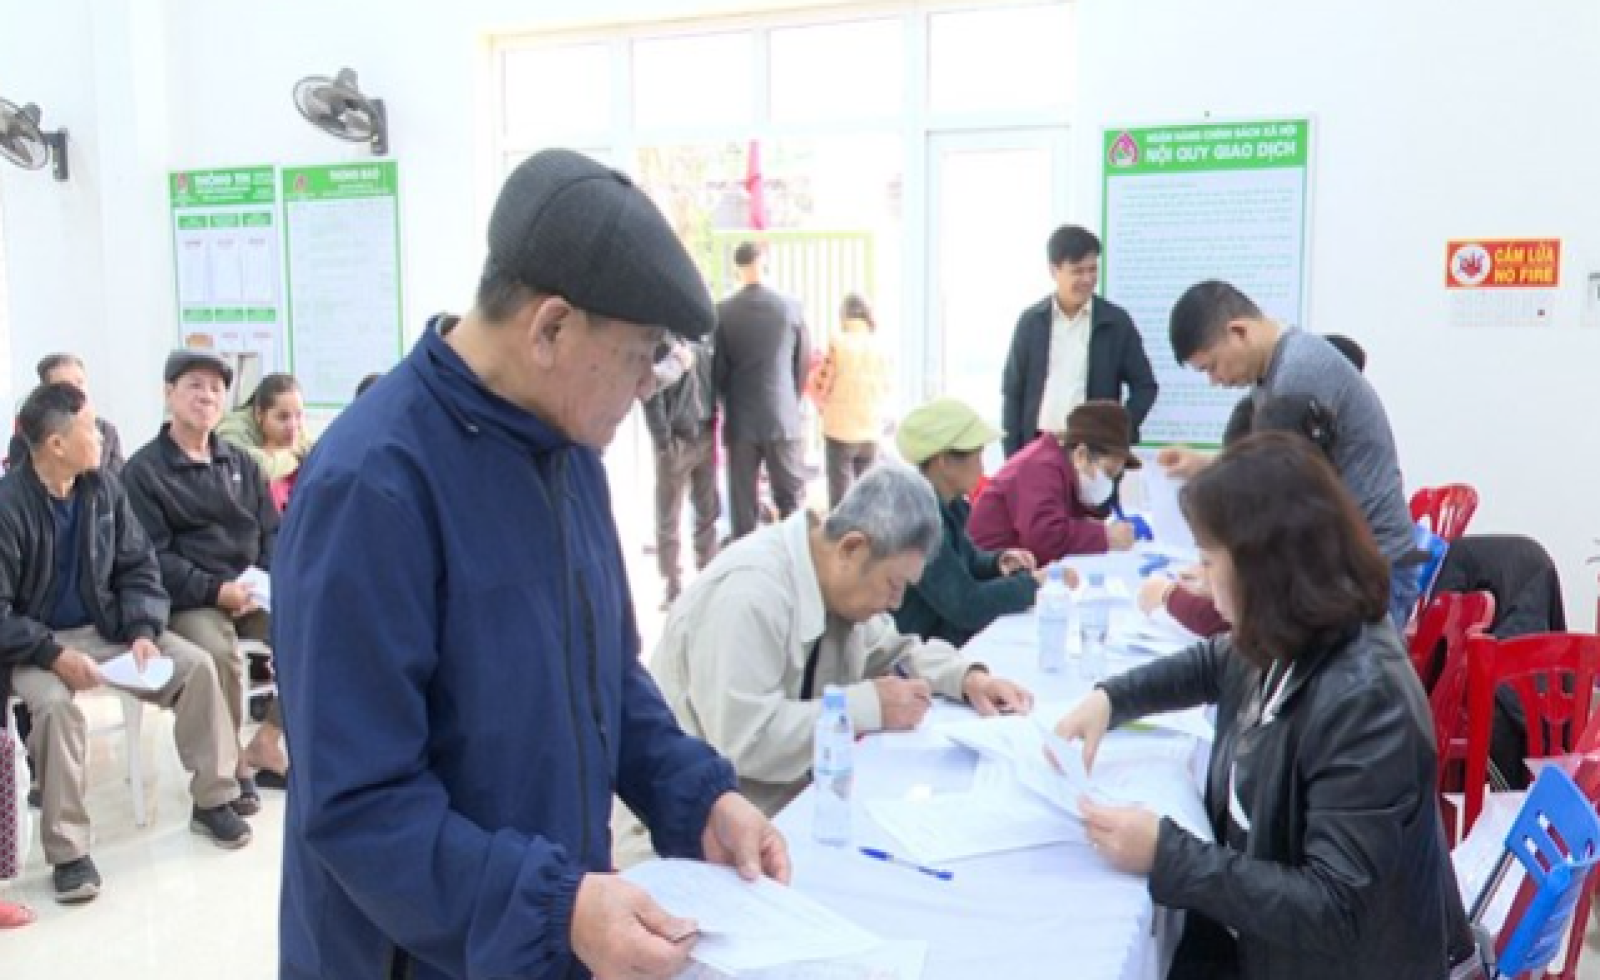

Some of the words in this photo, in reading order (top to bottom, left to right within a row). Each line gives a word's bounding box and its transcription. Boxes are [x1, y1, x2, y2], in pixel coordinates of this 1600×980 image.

[1146, 145, 1172, 165] NỘI
[1176, 145, 1209, 162] QUY
[1214, 143, 1254, 159] GIAO
[1257, 140, 1298, 161] DỊCH
[1494, 267, 1516, 283] NO
[1519, 267, 1554, 283] FIRE
